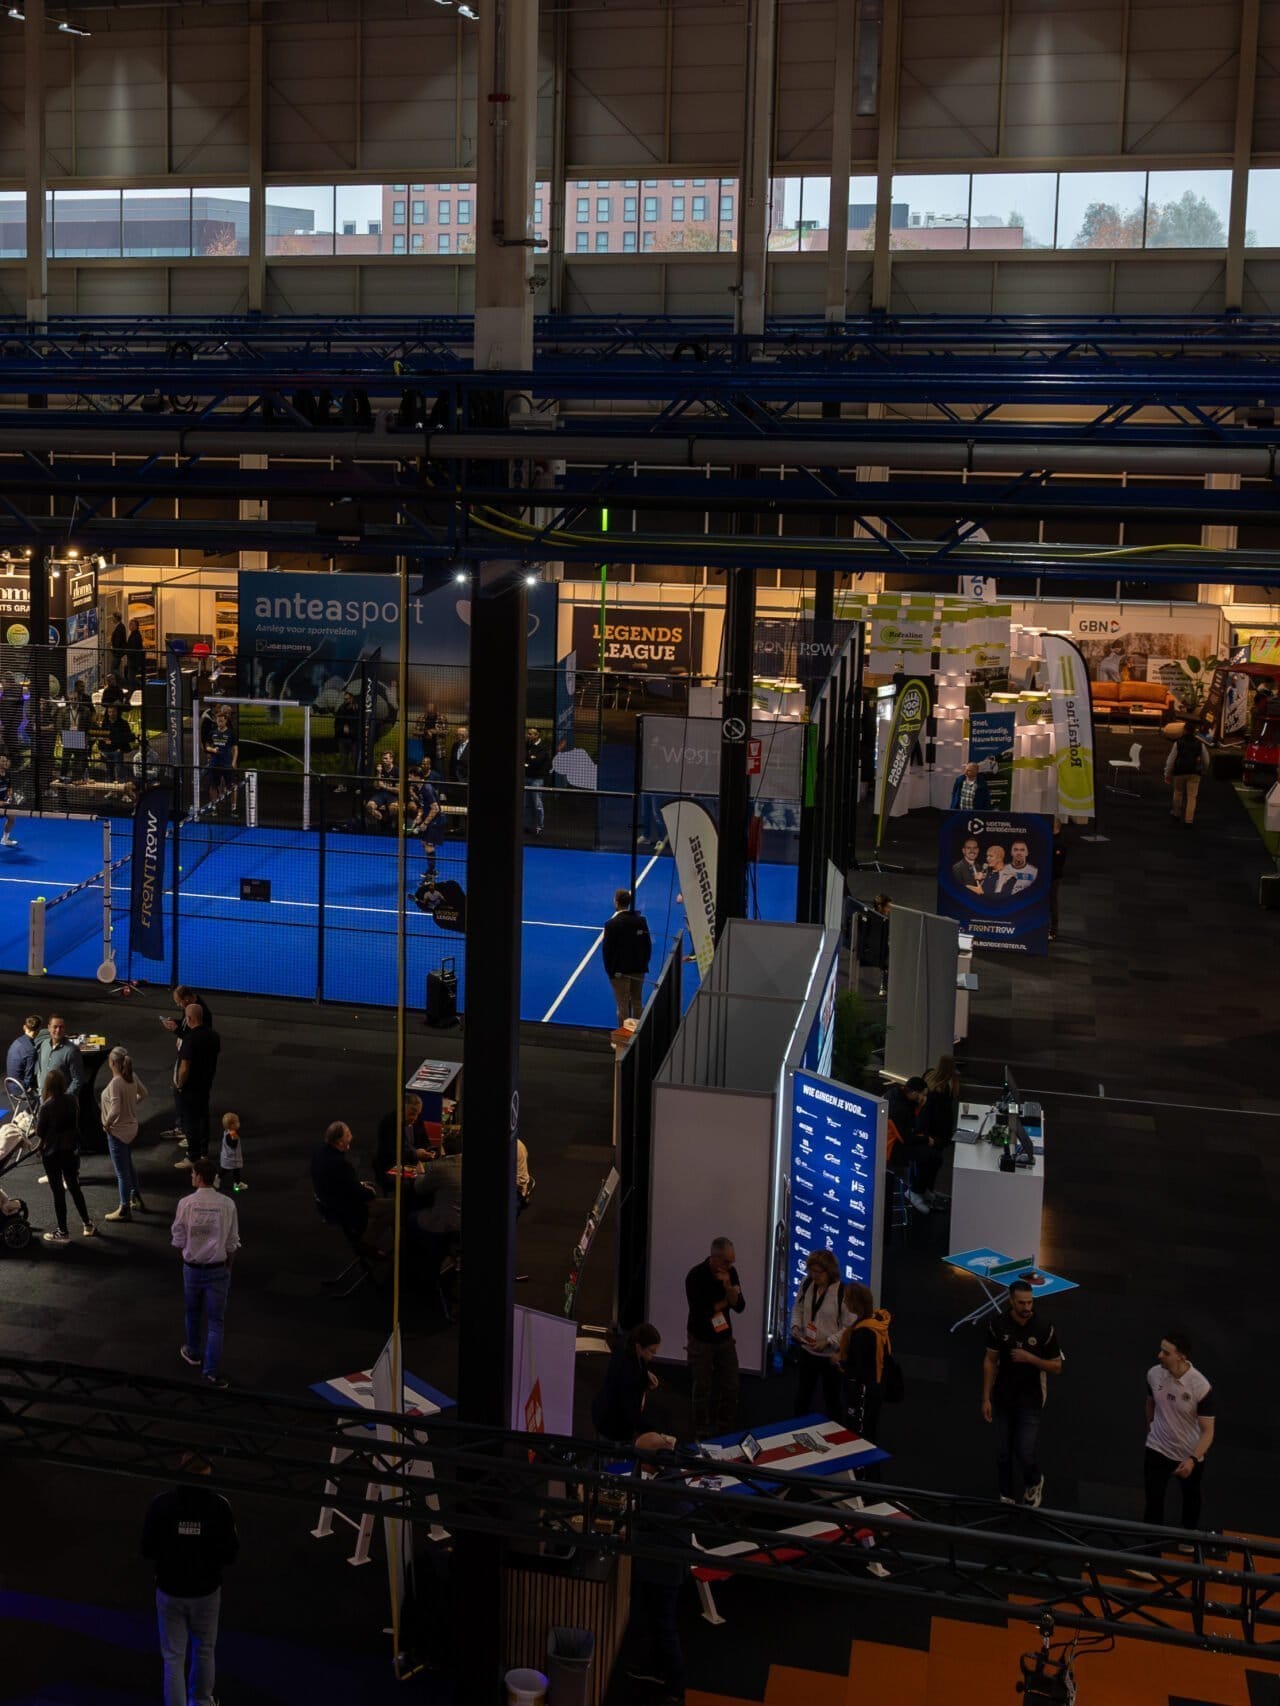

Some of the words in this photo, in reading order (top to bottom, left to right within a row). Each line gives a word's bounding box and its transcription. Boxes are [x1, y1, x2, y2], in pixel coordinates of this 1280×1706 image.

[255, 592, 424, 629] anteaspot
[255, 624, 285, 634] Aanleg
[286, 626, 306, 634] voor
[307, 627, 358, 636] sportvelden
[592, 624, 683, 643] LEGENDS
[1079, 620, 1109, 633] GBN
[598, 643, 677, 661] LEAGUE
[141, 809, 159, 929] FRONTROW
[968, 924, 1016, 935] FRONTROW
